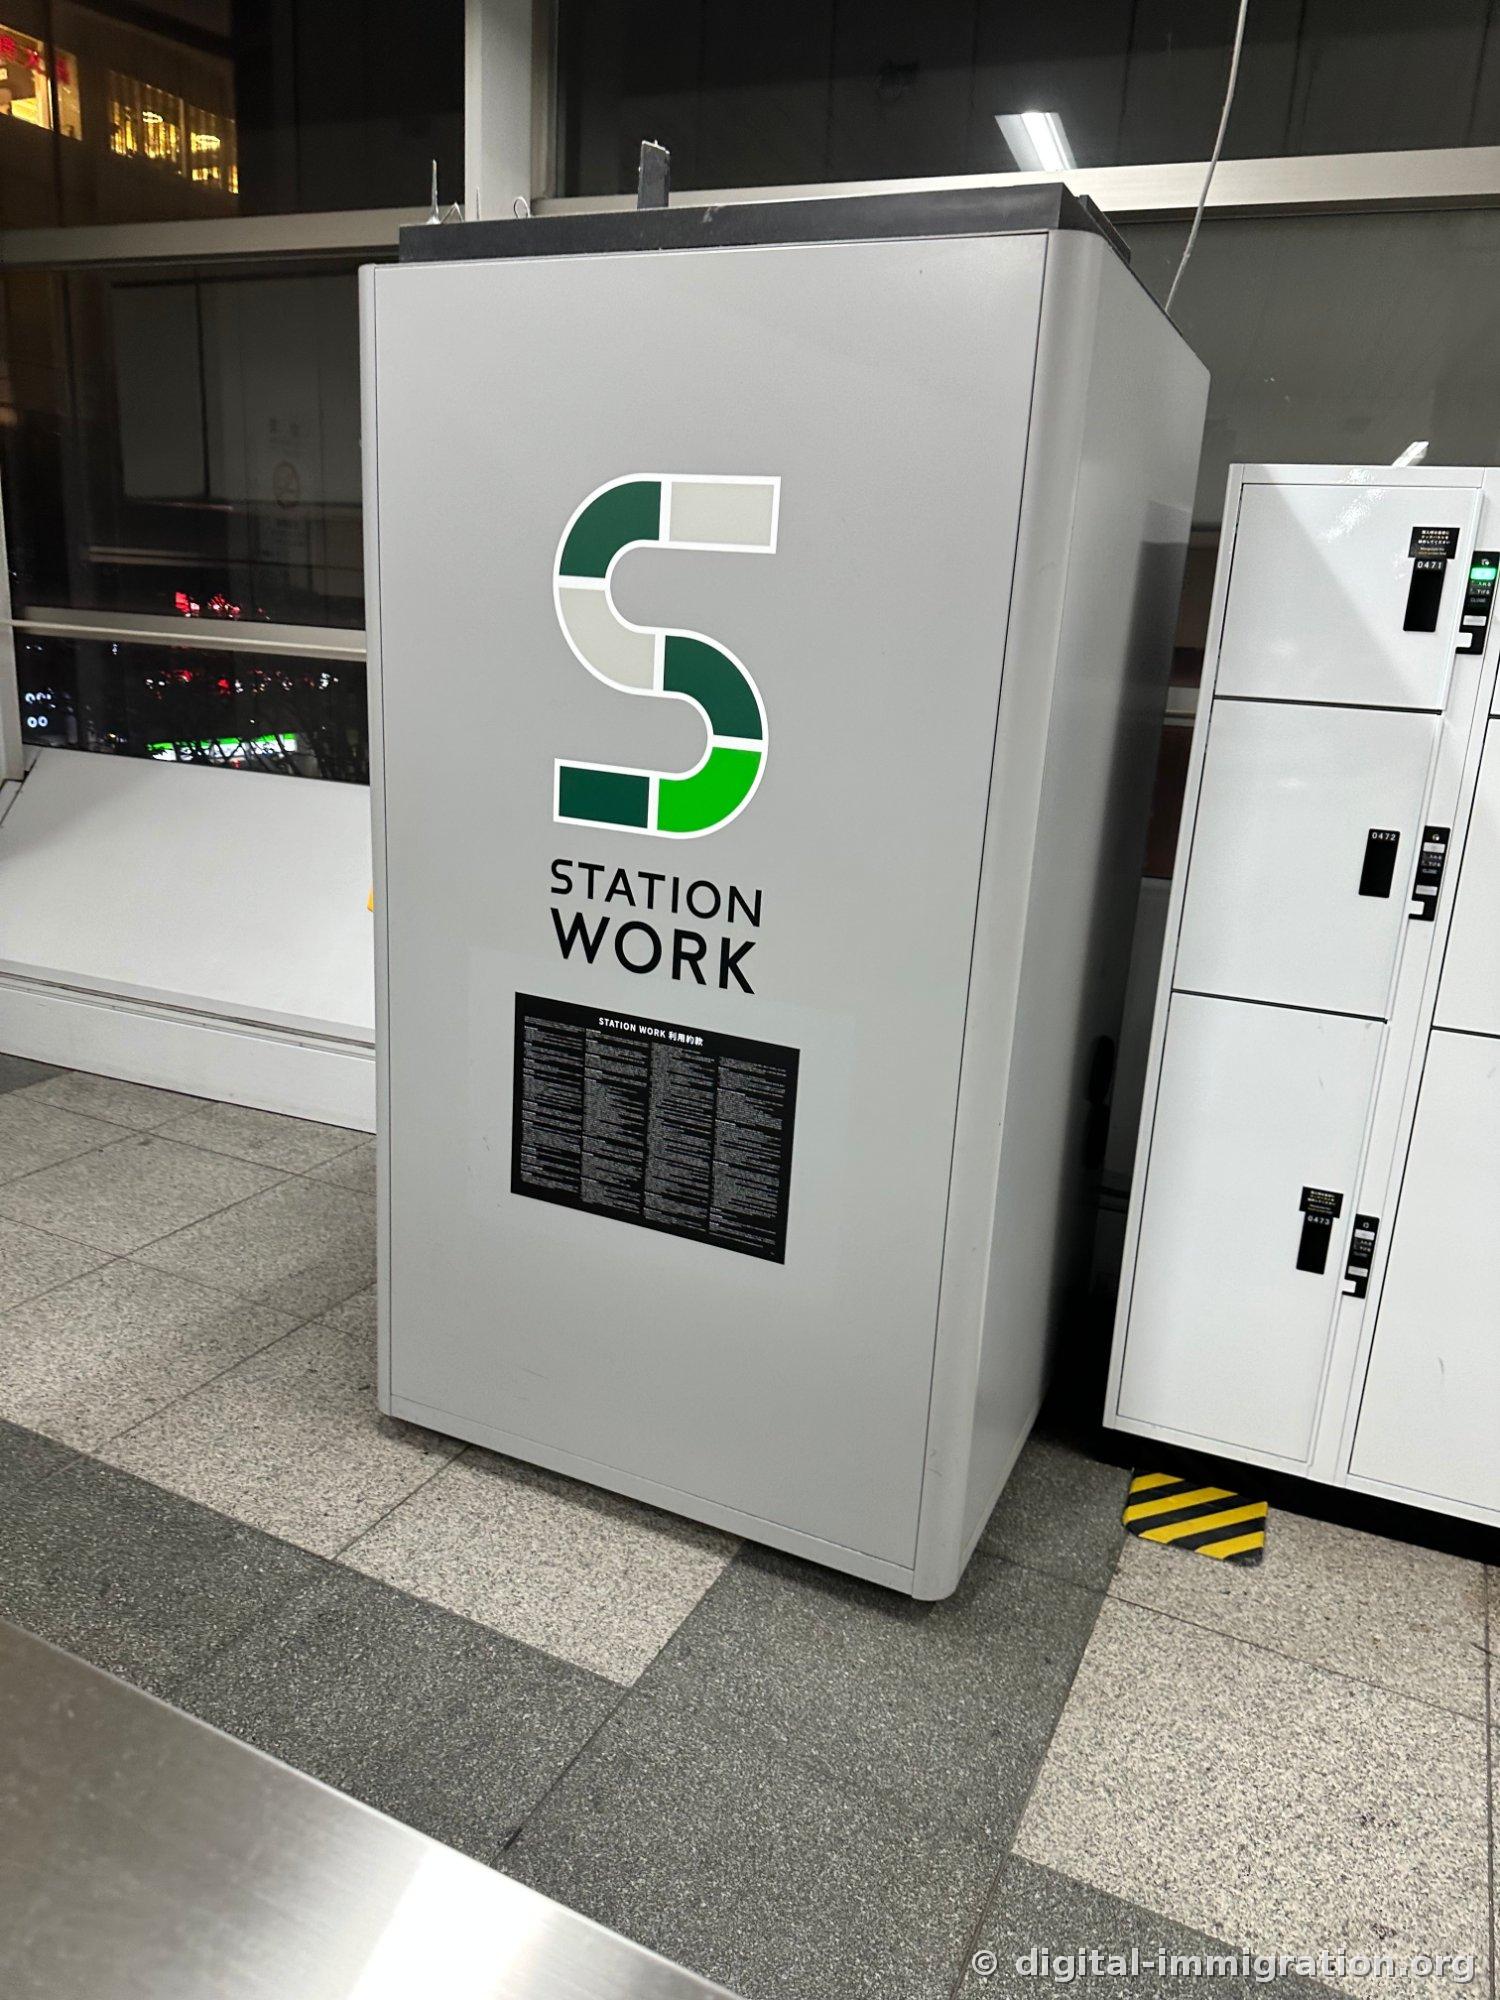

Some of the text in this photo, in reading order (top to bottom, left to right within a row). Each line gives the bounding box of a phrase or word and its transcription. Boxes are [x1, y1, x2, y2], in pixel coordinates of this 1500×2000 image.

[1417, 561, 1442, 569] 0471
[1371, 832, 1396, 841] 0472
[550, 858, 762, 928] STATION
[550, 906, 757, 995] WORK
[598, 1017, 704, 1047] STATION WORK 利用約款
[1307, 1215, 1330, 1225] 0473
